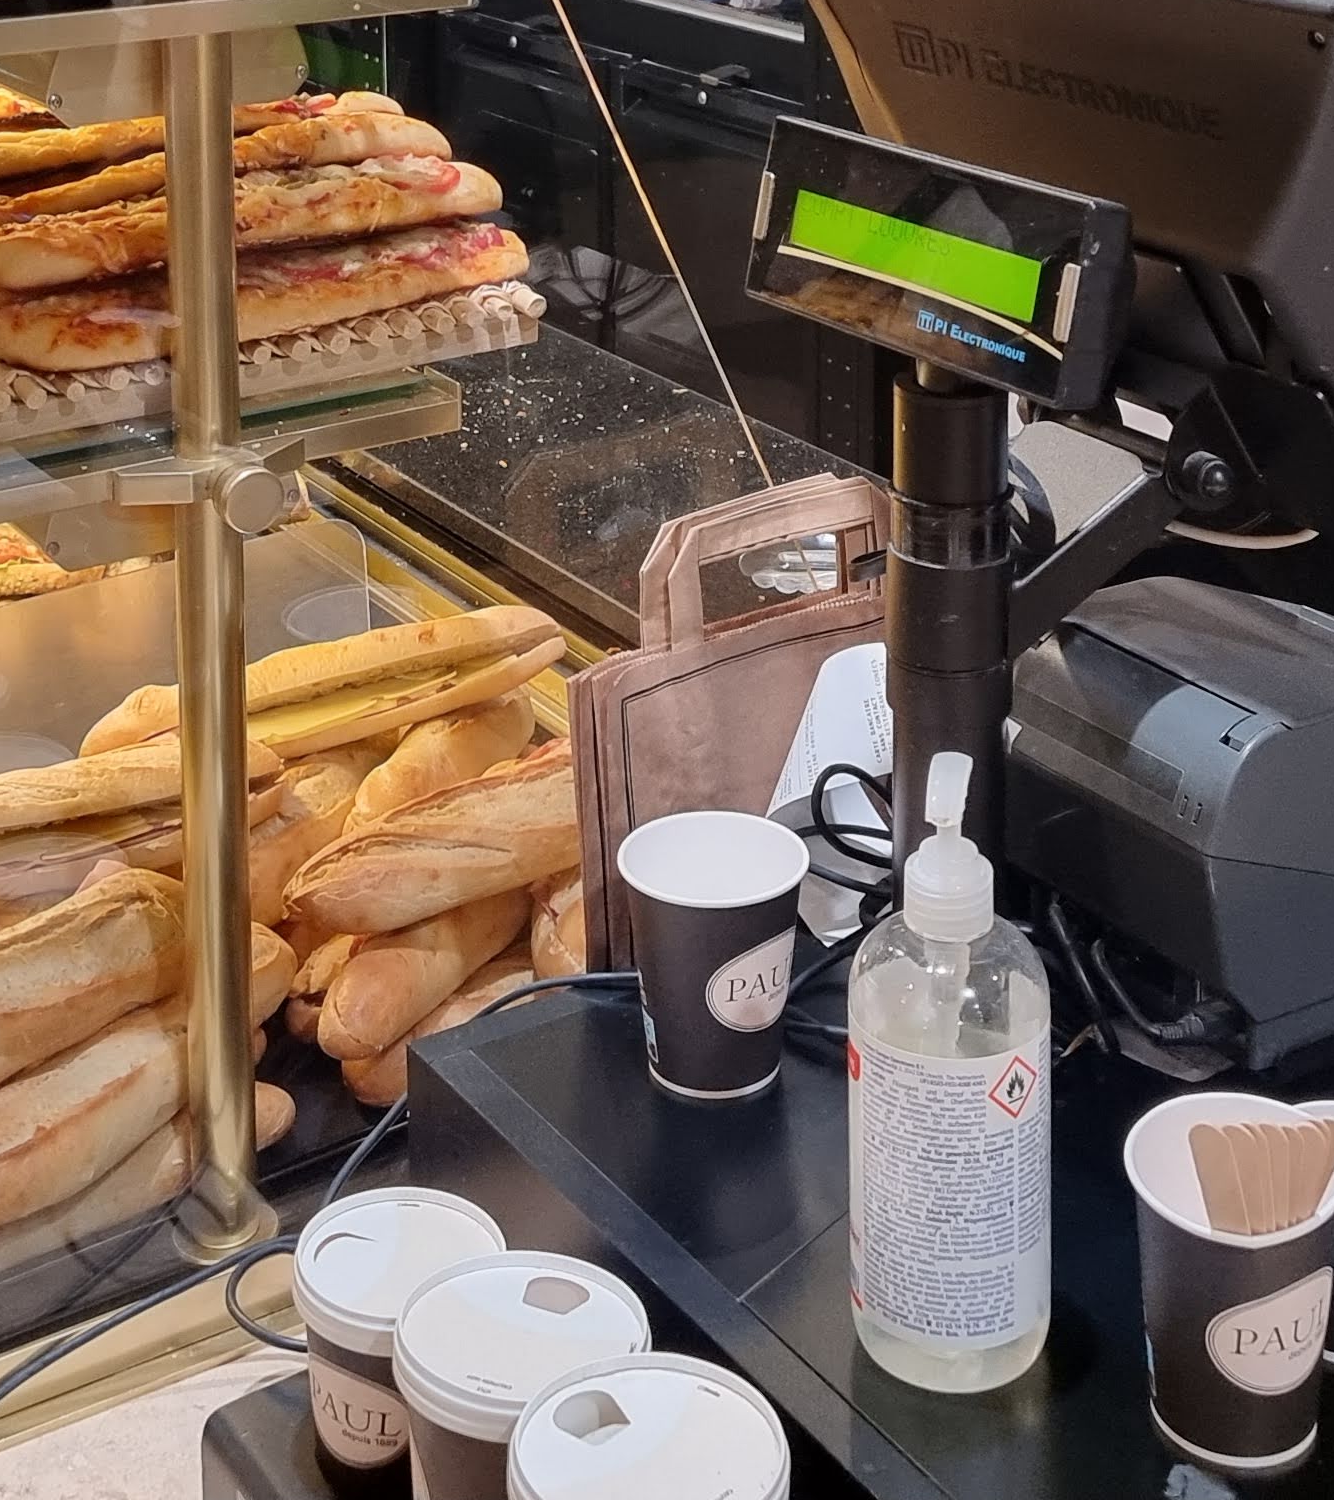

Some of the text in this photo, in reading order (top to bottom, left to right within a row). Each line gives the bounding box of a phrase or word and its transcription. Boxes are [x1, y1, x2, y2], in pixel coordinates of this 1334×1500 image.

[979, 47, 1225, 141] ELECTRONIQUE
[934, 318, 1027, 363] PI ELECTRONIQUE
[863, 699, 883, 764] CARTE BANCAIRE
[870, 697, 886, 752] SANS CONTACT
[726, 950, 793, 1003] PAU
